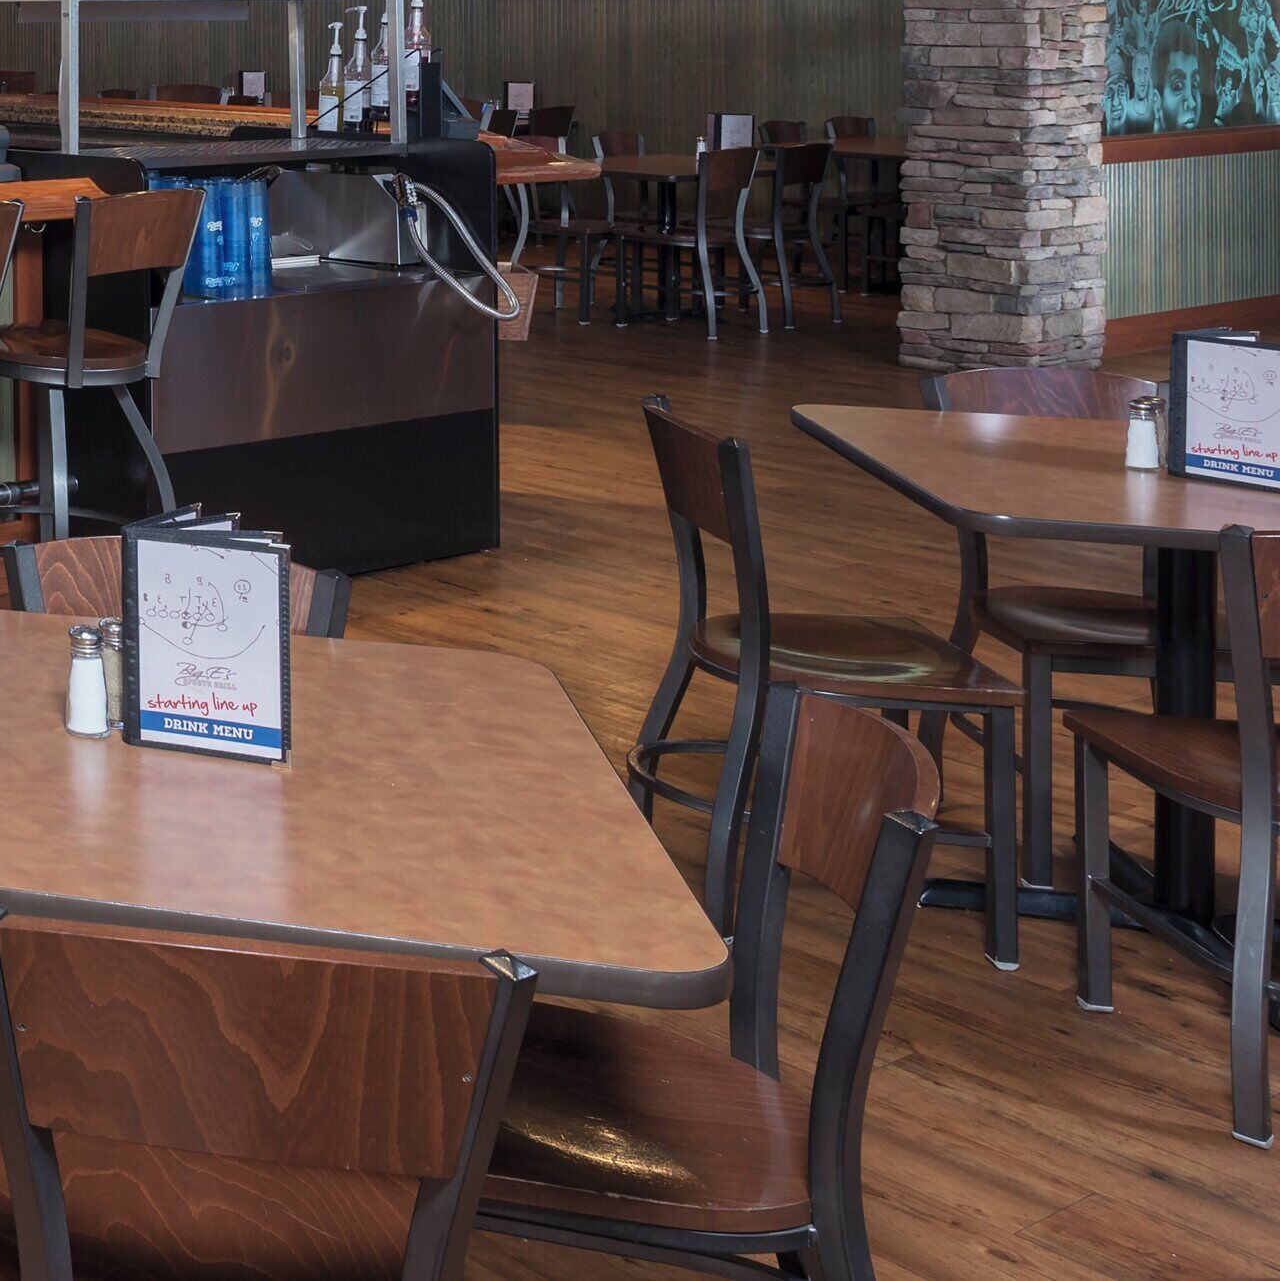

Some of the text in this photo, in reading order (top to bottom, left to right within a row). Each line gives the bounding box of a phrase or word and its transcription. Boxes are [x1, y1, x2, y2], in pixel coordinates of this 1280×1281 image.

[1191, 443, 1278, 462] starting line up
[1203, 459, 1275, 478] DRINK MENU
[147, 692, 258, 717] starting line up
[163, 717, 254, 740] DRINK MENU
